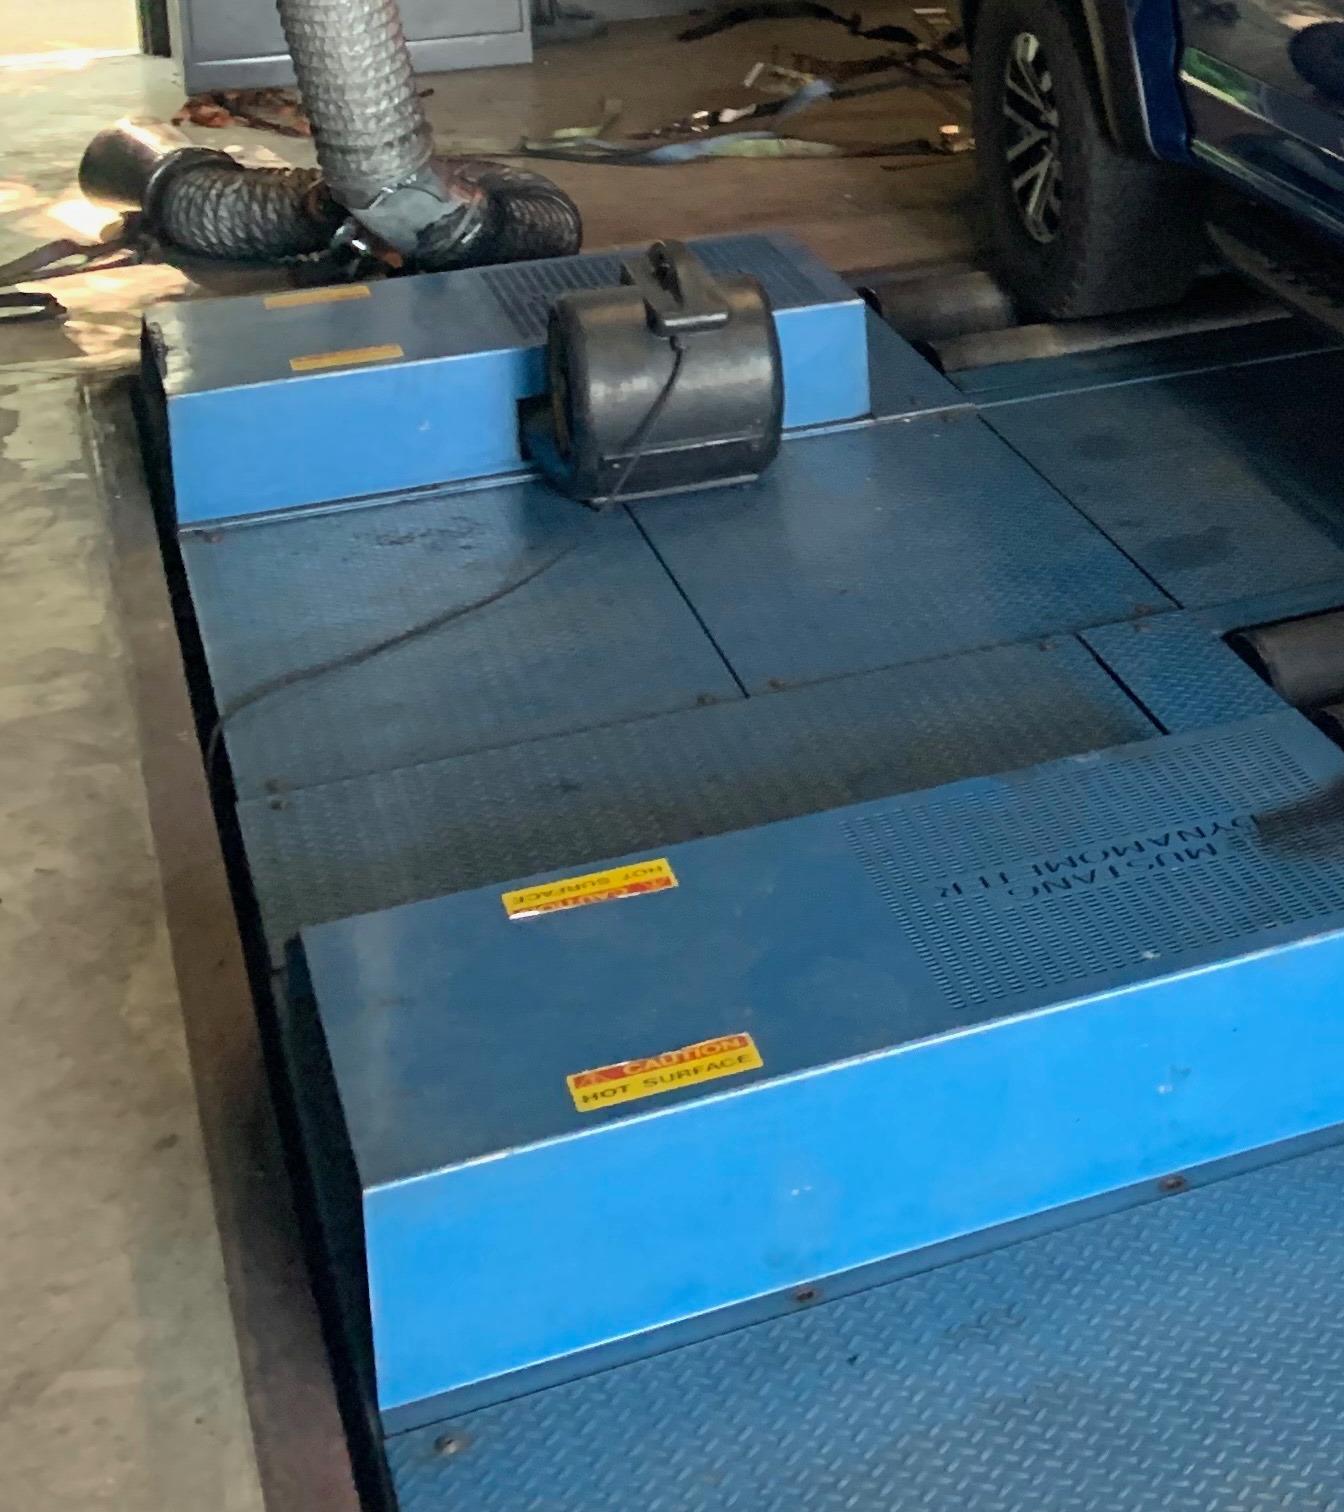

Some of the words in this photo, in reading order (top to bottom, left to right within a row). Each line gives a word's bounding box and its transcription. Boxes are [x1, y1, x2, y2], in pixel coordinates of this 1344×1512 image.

[622, 864, 664, 882] HOT
[1007, 841, 1219, 899] MUSTANG
[511, 876, 612, 905] SURFACE
[622, 1037, 741, 1075] CAUTION
[581, 1083, 631, 1104] HOT
[642, 1053, 753, 1088] SURFACE
